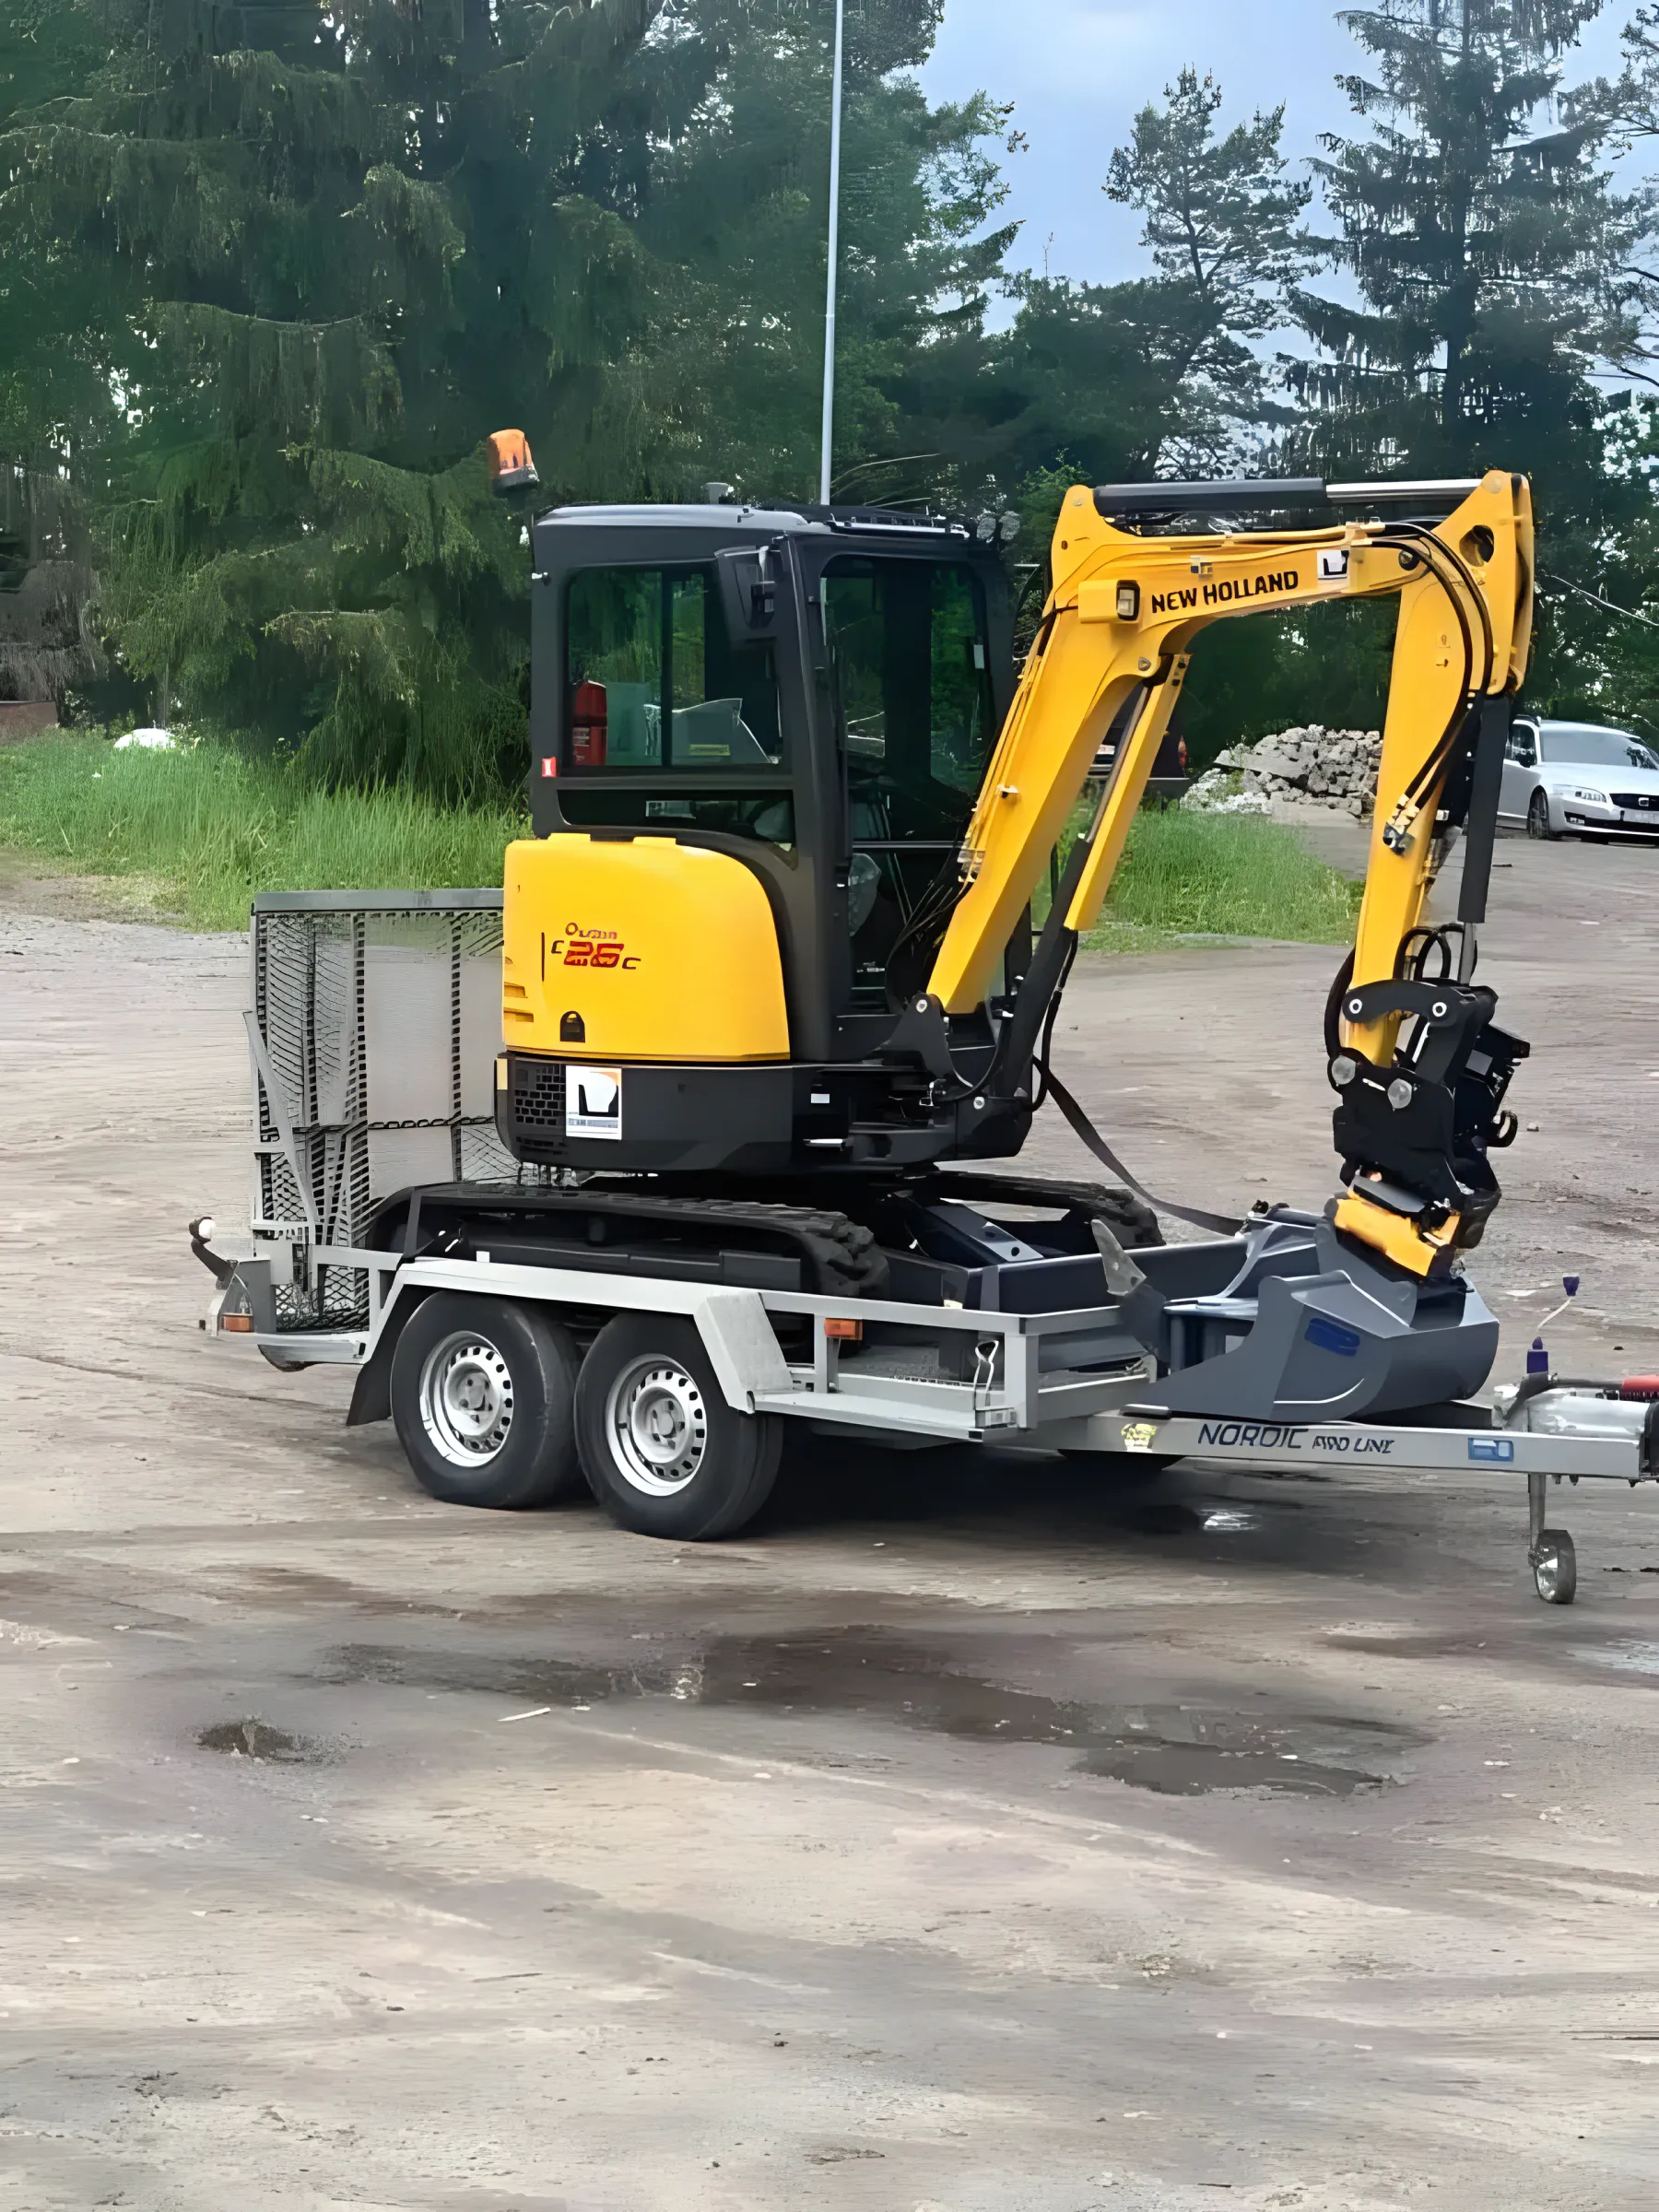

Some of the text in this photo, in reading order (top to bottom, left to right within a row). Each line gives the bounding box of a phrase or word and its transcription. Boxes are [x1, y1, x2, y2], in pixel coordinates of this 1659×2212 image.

[1151, 571, 1299, 614] NEW HOLLAND
[1197, 1423, 1310, 1450] NORDIC
